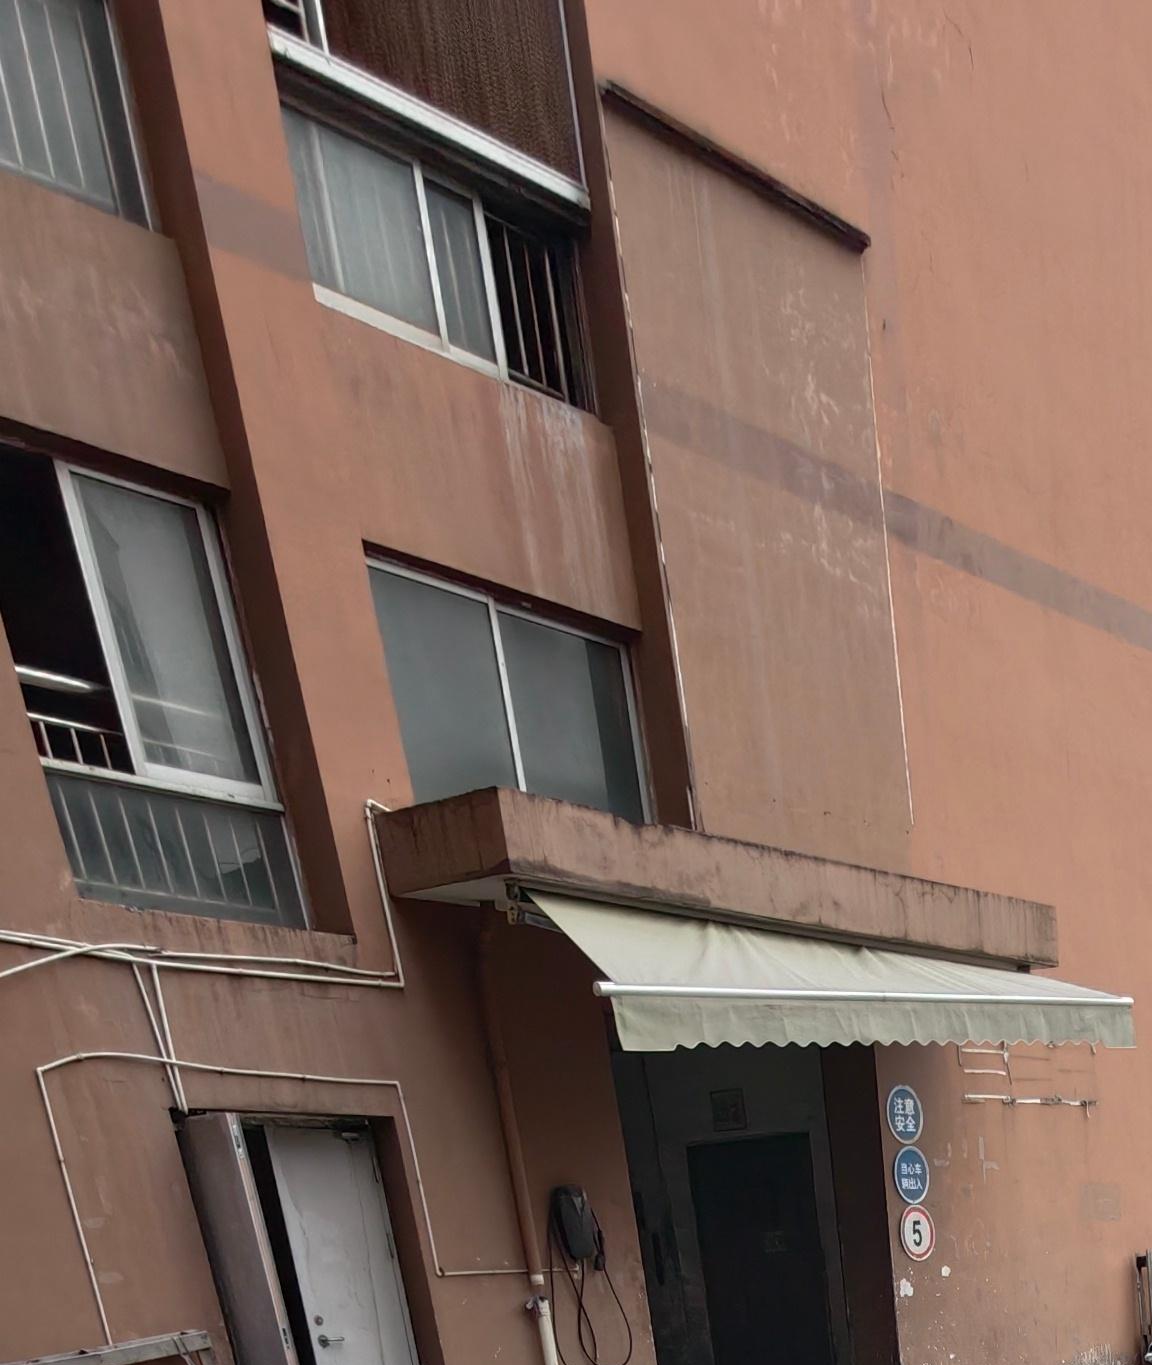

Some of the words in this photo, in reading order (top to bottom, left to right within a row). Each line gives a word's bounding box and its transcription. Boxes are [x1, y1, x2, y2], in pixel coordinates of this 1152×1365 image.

[894, 1097, 916, 1116] 注意
[895, 1115, 917, 1132] 安全
[901, 1162, 922, 1175] 当心车
[912, 1219, 923, 1247] 5
